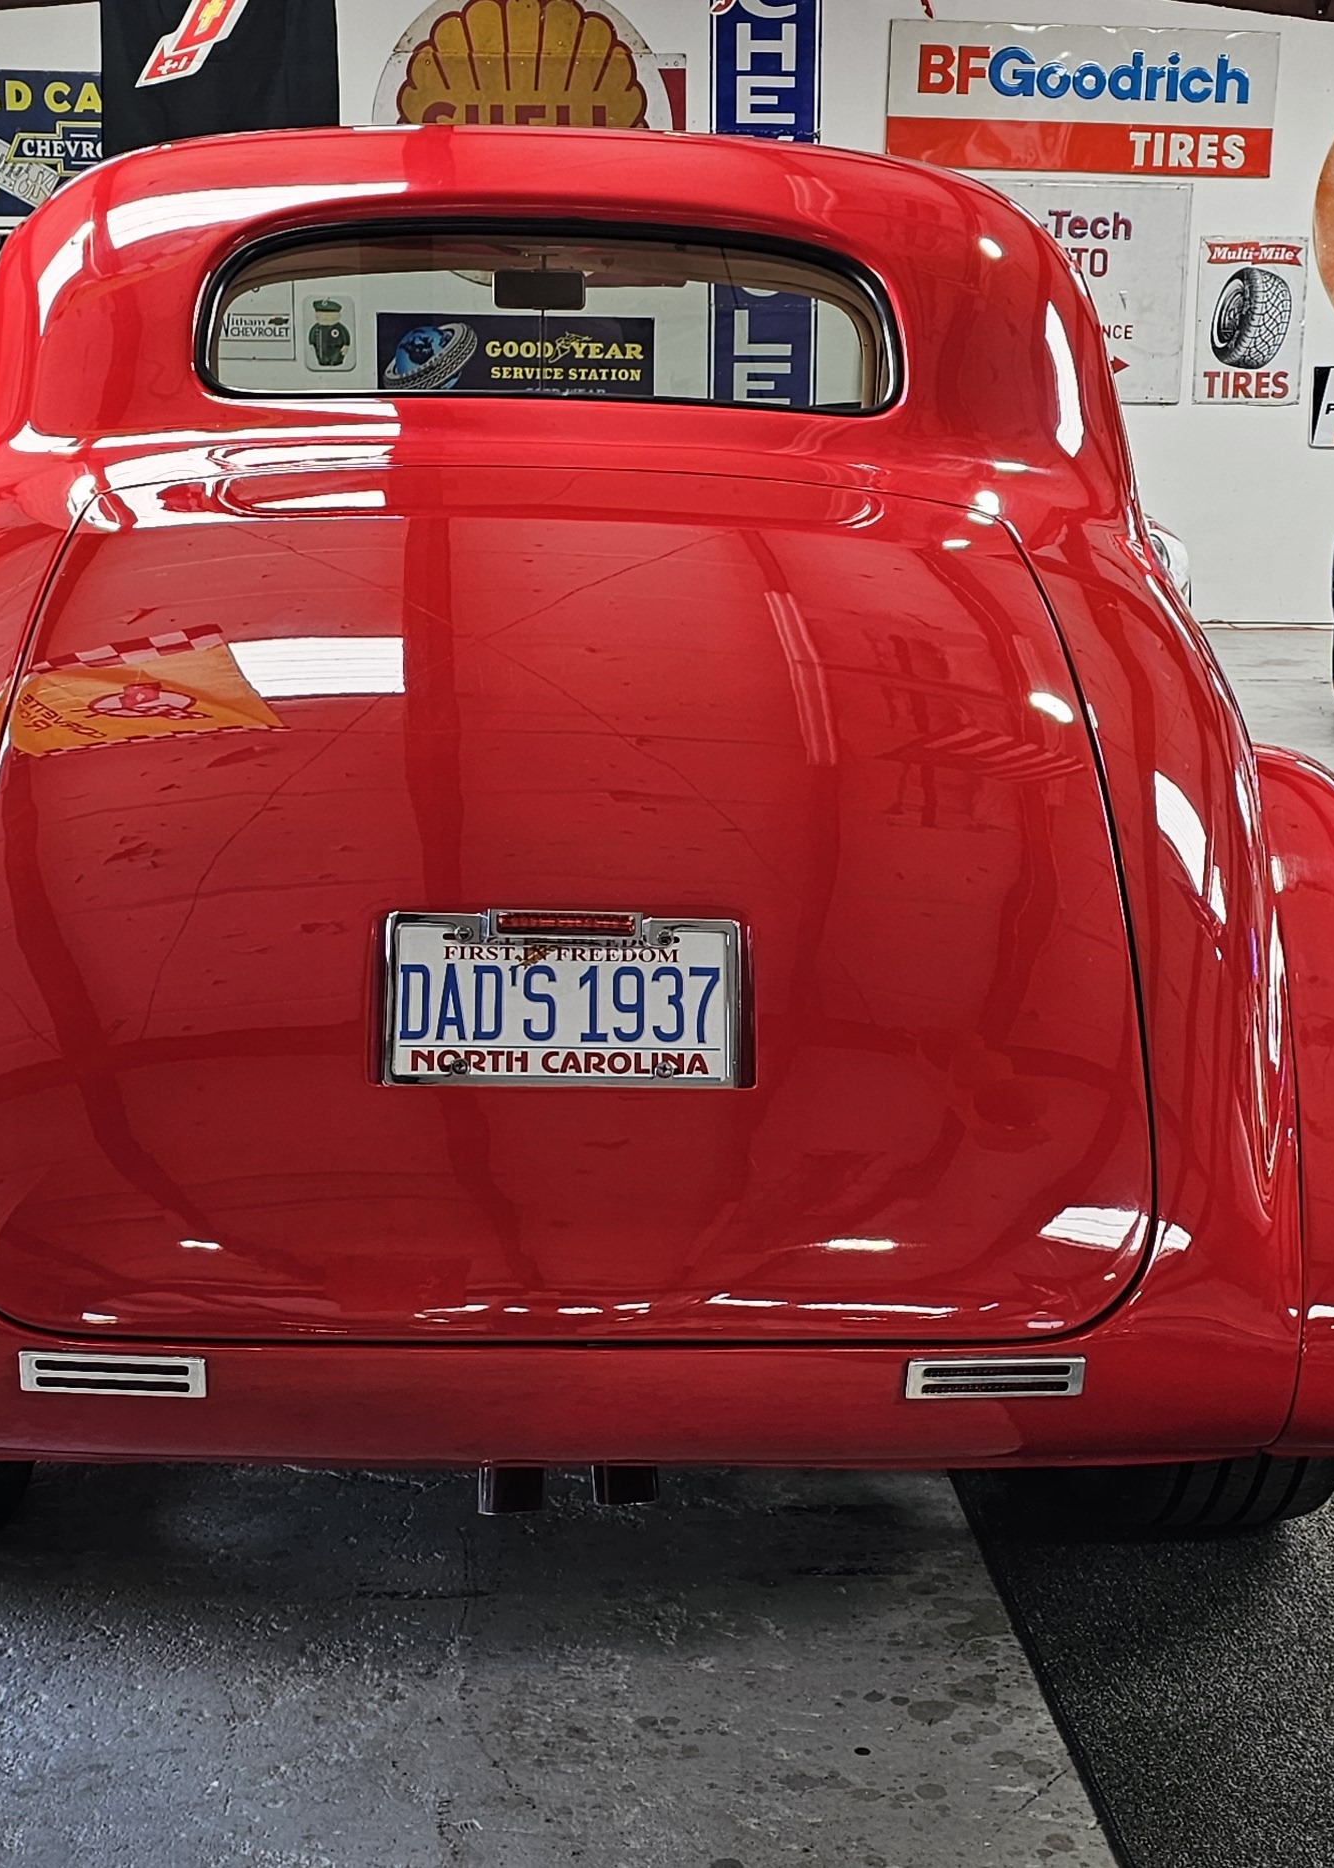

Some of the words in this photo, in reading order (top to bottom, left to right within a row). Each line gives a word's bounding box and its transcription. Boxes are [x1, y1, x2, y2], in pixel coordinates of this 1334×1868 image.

[917, 44, 1250, 104] BFGoodrich
[1129, 131, 1246, 170] TIRES
[1210, 246, 1297, 261] Multi-Mile
[230, 326, 291, 338] CHEVROLET
[485, 341, 553, 359] GOOD
[568, 342, 645, 360] YEAR
[491, 366, 564, 379] SERVICE
[568, 368, 642, 381] STATION
[1203, 371, 1290, 399] TIRES
[443, 945, 514, 962] FIRST
[555, 946, 679, 963] FREEDOM
[399, 963, 557, 1043] DAD'S
[578, 965, 721, 1044] 1937
[411, 1049, 529, 1073] NORTH
[541, 1050, 709, 1075] CAROLINA
